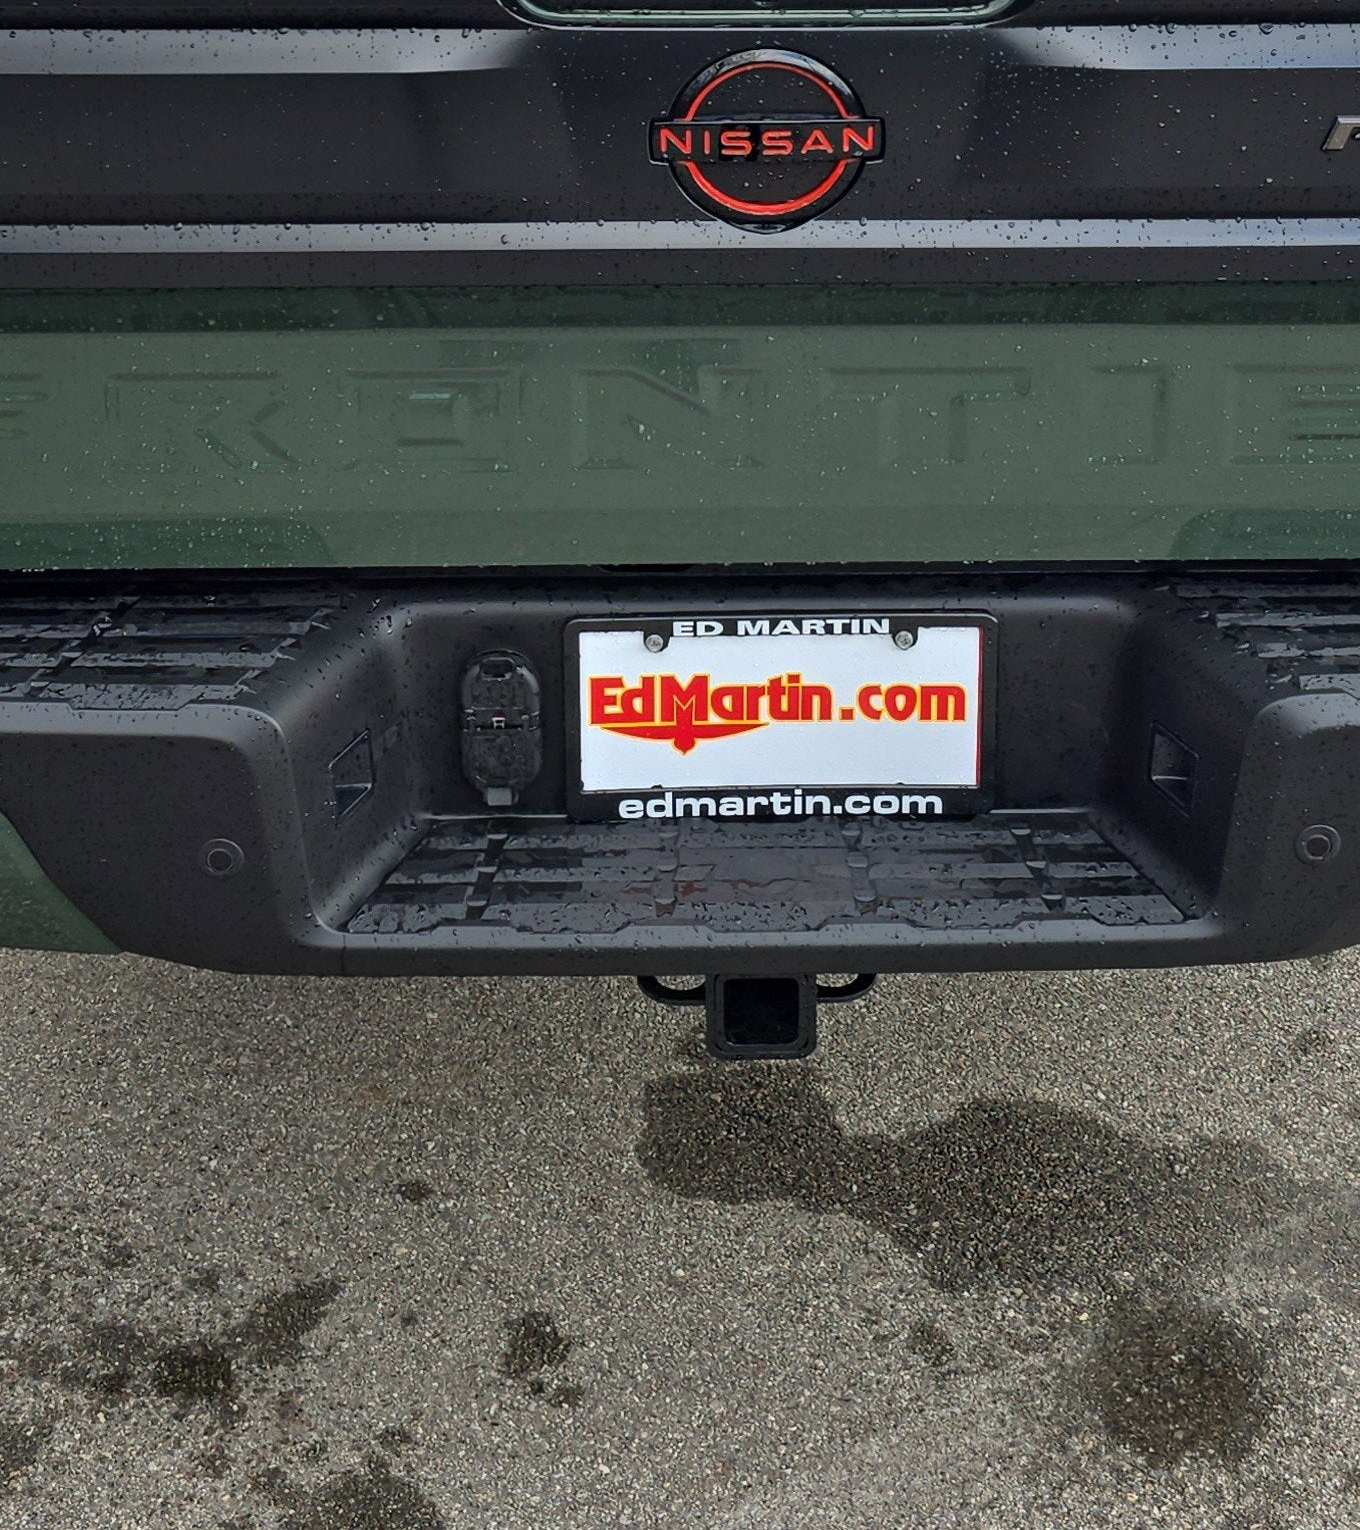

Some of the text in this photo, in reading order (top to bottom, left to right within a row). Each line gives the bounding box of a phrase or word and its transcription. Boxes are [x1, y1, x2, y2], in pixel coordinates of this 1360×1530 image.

[659, 126, 874, 156] NISSAN
[673, 618, 890, 636] ED MARTIN
[618, 788, 943, 820] edmartin.com
